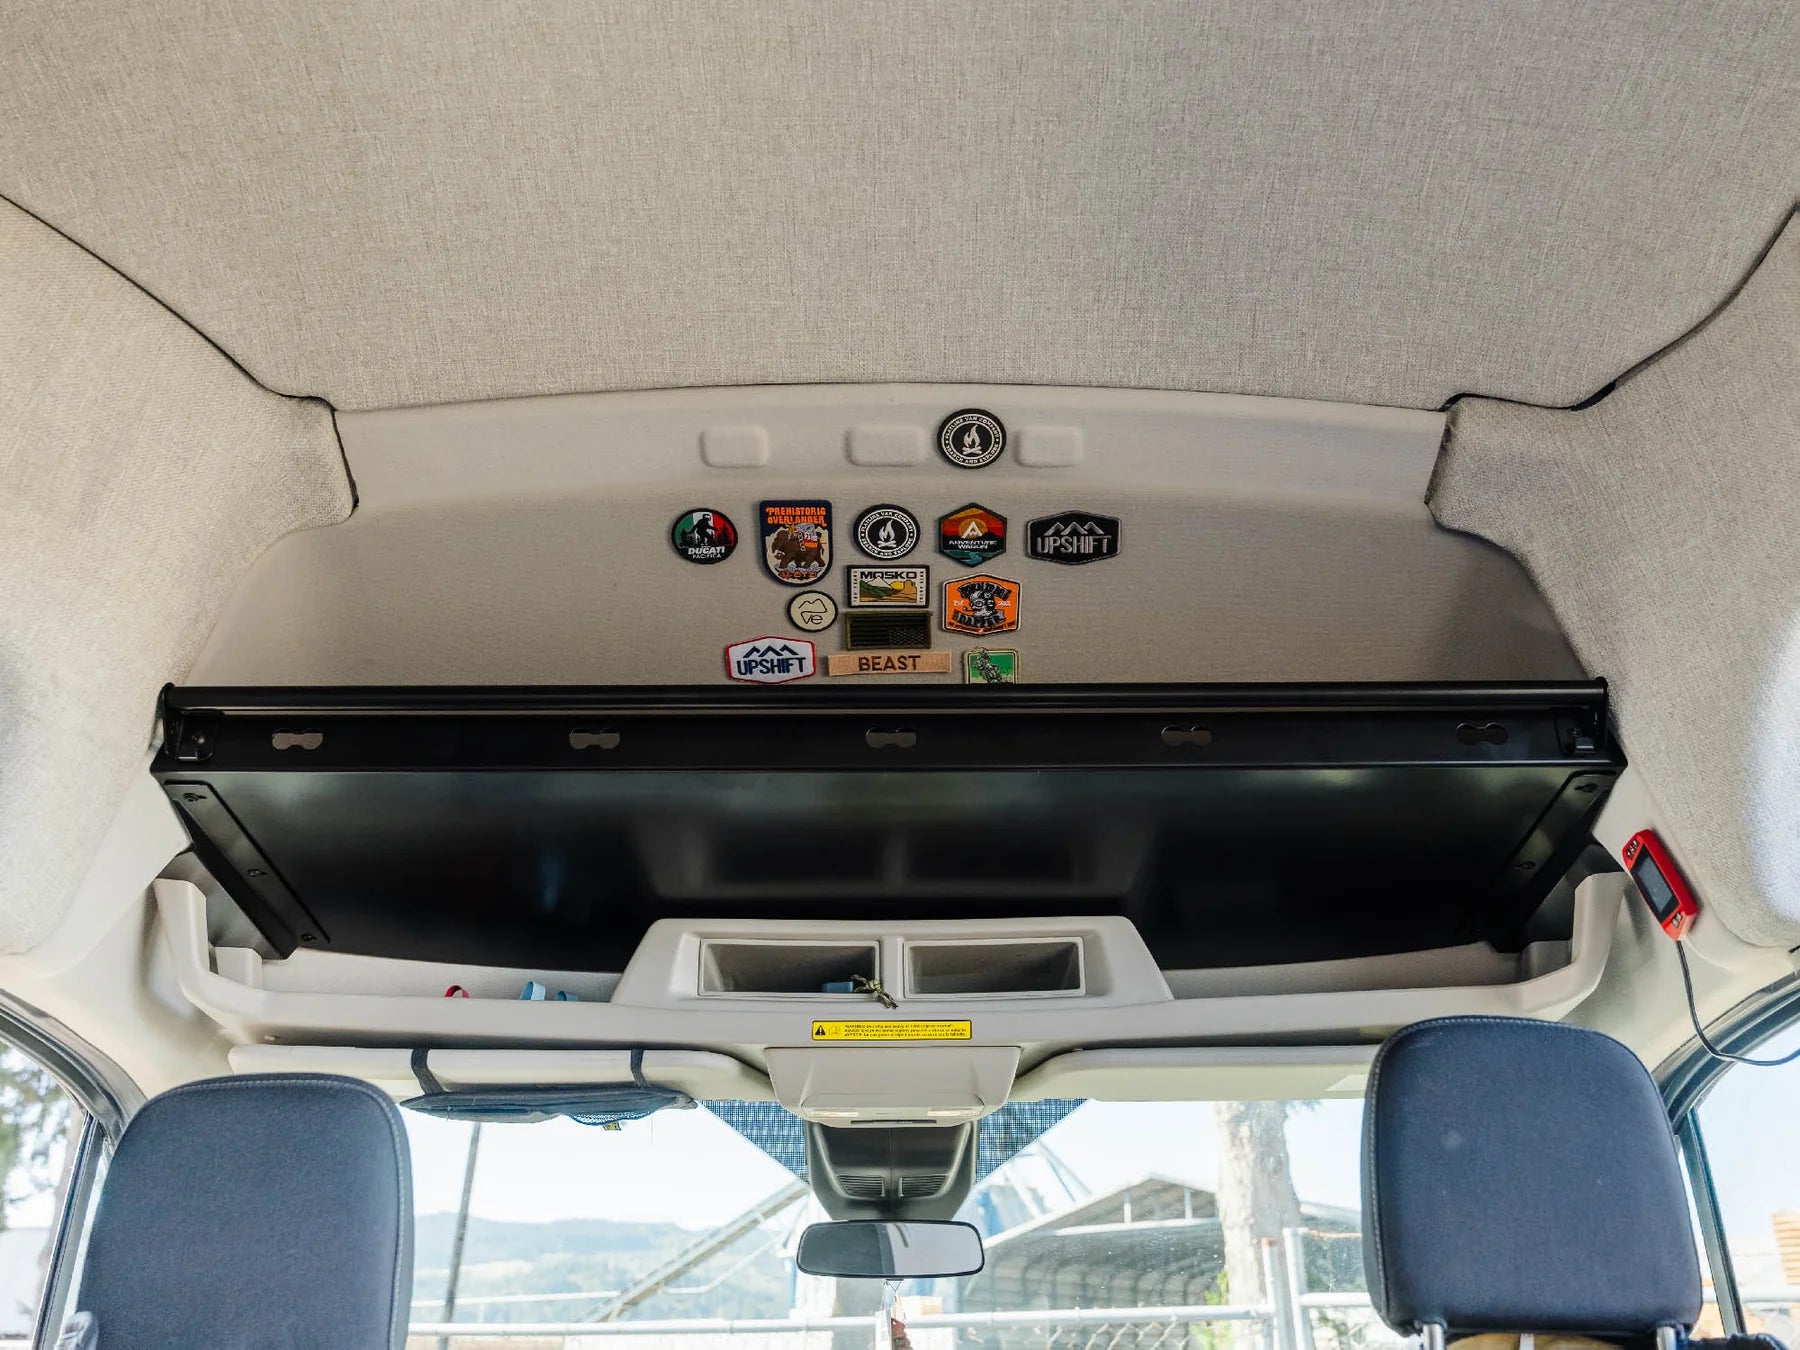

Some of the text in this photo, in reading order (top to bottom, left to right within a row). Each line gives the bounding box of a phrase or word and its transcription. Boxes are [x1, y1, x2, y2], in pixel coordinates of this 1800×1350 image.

[979, 417, 1000, 438] COMPANY
[946, 445, 964, 463] SEARCH
[979, 444, 999, 463] EXPLORE
[766, 507, 826, 515] PREHISTORIC
[767, 516, 827, 527] OVERLANDER
[894, 513, 913, 532] COMPANY
[687, 546, 726, 555] DUCATI
[1036, 535, 1112, 554] UPSHIFT
[859, 571, 917, 579] MOSKO
[736, 657, 806, 676] UPSHIFT
[858, 655, 921, 671] BEAST
